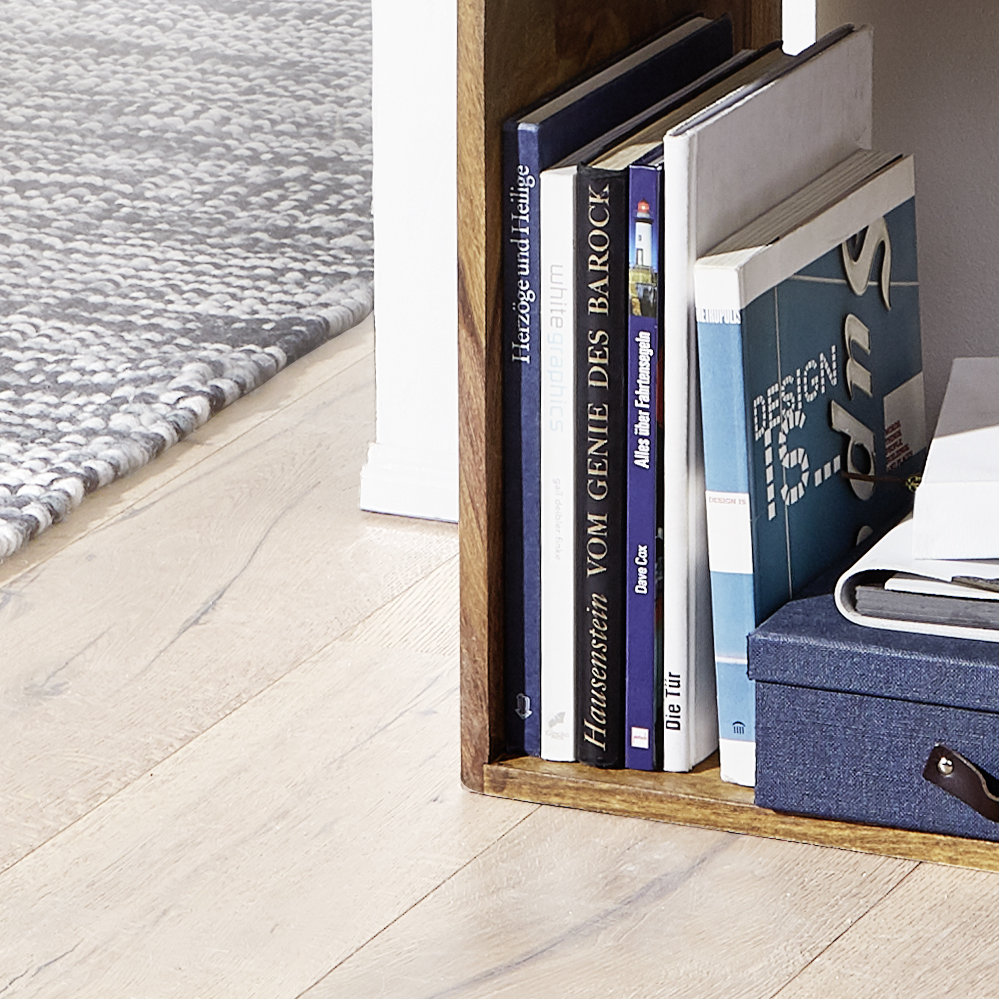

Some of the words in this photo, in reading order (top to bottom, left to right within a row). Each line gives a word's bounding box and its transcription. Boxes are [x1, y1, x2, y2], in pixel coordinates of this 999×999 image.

[510, 164, 535, 236] Heilige
[510, 238, 530, 277] und
[588, 184, 610, 315] BAROCK
[511, 279, 535, 365] Herzöge
[588, 330, 609, 390] DES
[634, 331, 654, 408] Fahrtensegeln
[633, 410, 650, 436] über
[754, 345, 837, 441] DESIGN
[587, 403, 609, 501] GENIE
[633, 438, 650, 469] Alles
[586, 512, 608, 578] VOM
[635, 545, 648, 567] Cox
[635, 567, 648, 595] Dave
[583, 592, 609, 750] Hausenstein
[665, 671, 682, 699] Tür
[665, 701, 682, 730] Die
